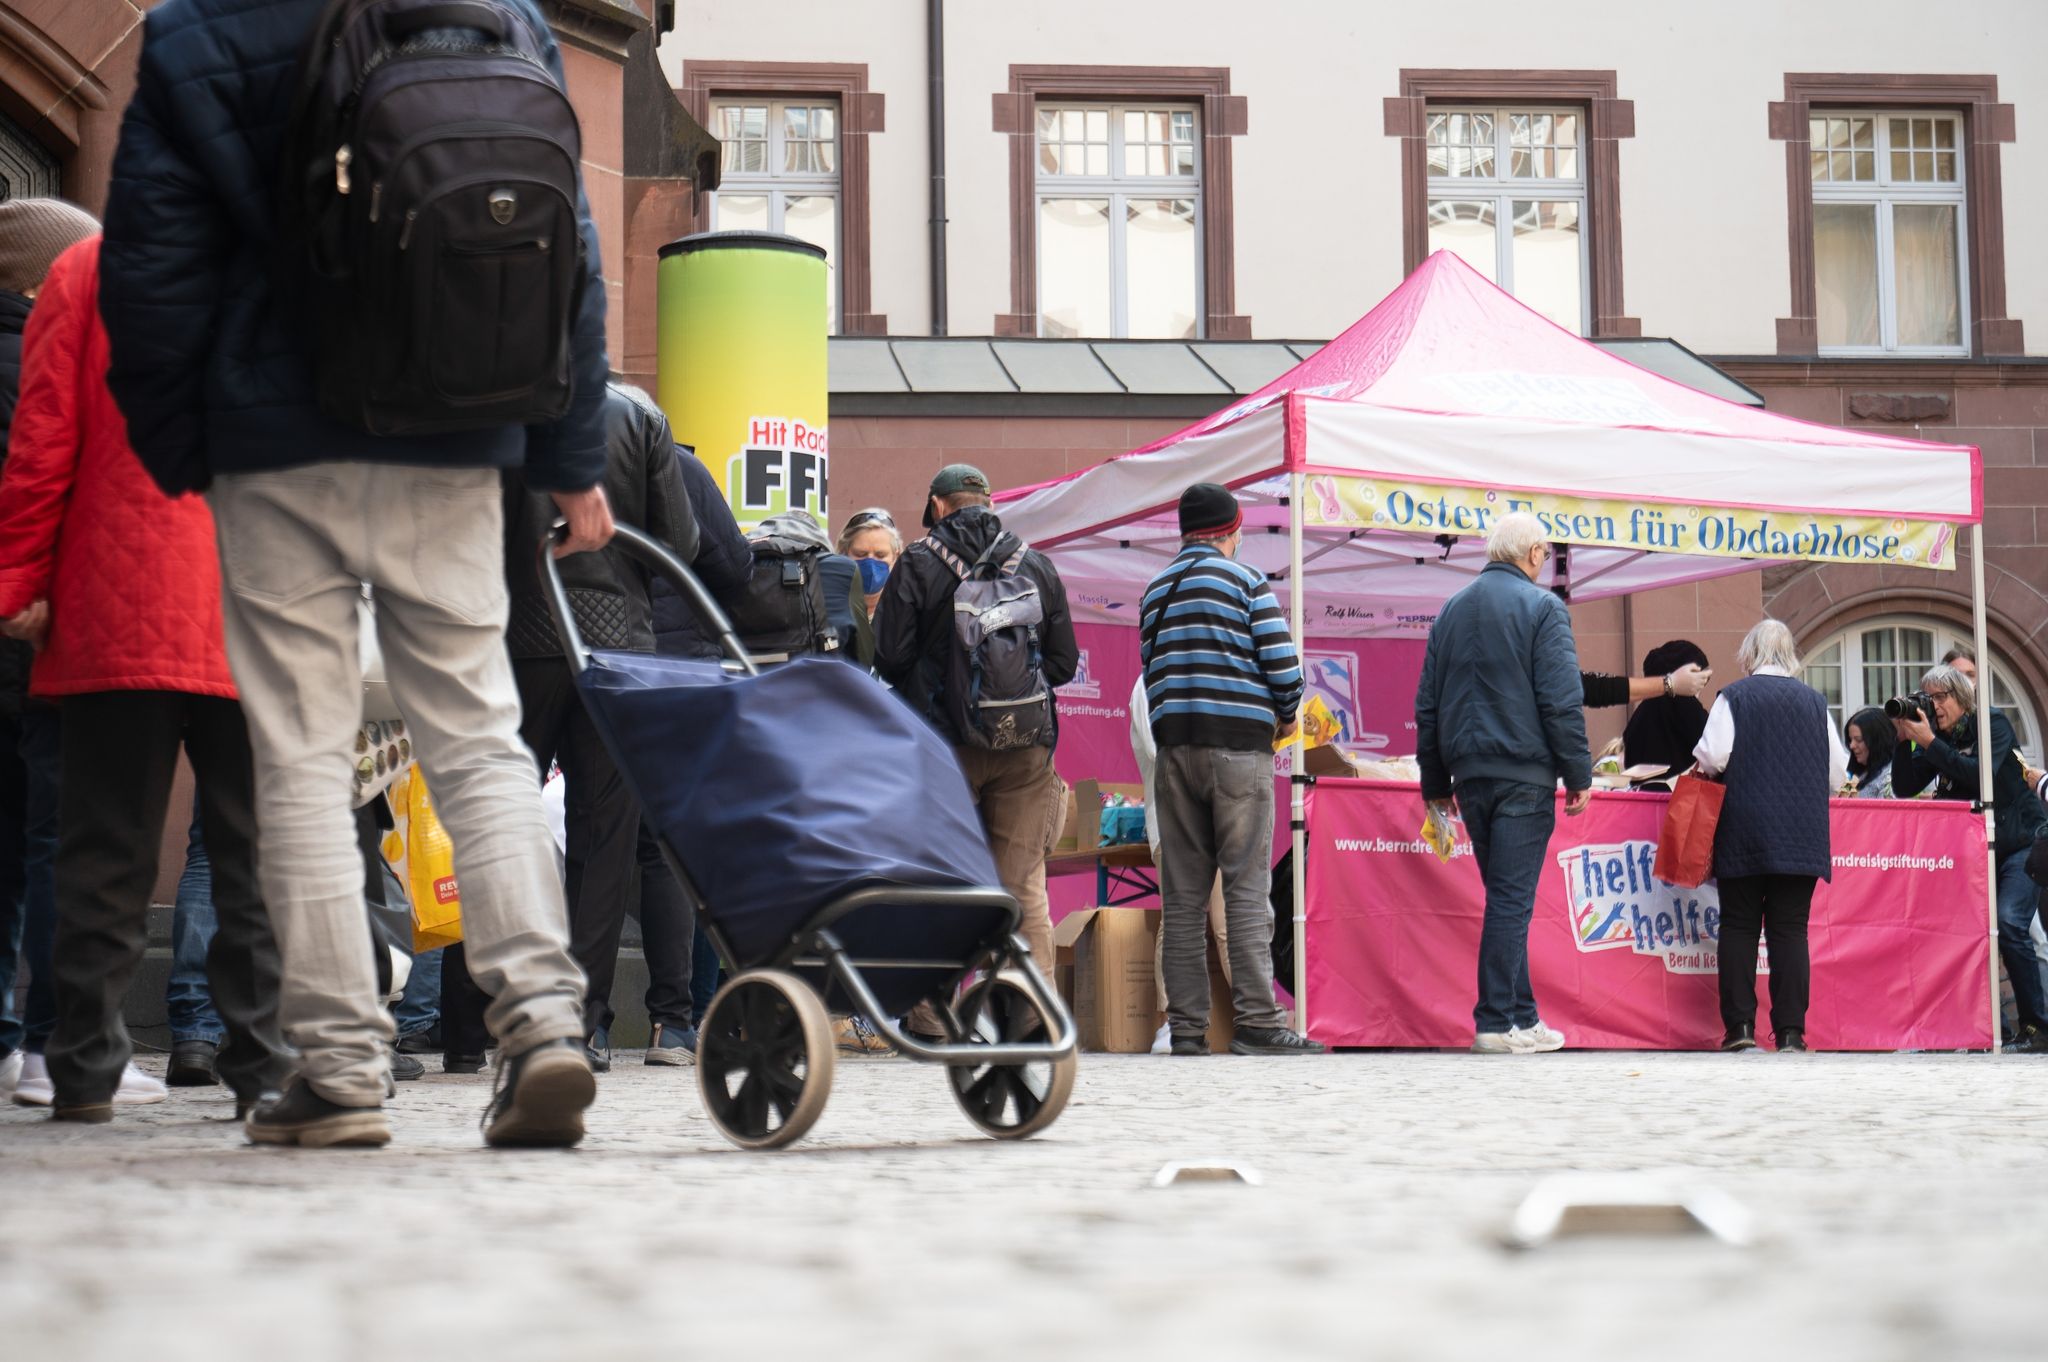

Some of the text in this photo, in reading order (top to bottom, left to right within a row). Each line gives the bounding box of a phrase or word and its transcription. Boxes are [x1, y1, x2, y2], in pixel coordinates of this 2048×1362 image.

[752, 421, 828, 453] Hit Rad
[1628, 508, 1687, 548] für
[1697, 515, 1899, 559] Obdachlose
[1397, 615, 1436, 623] PEPSIC
[1581, 843, 1674, 898] helf
[1832, 853, 1954, 872] rndreisigstiftung.de
[1630, 897, 1720, 951] helfe
[1669, 952, 1700, 969] Bernd
